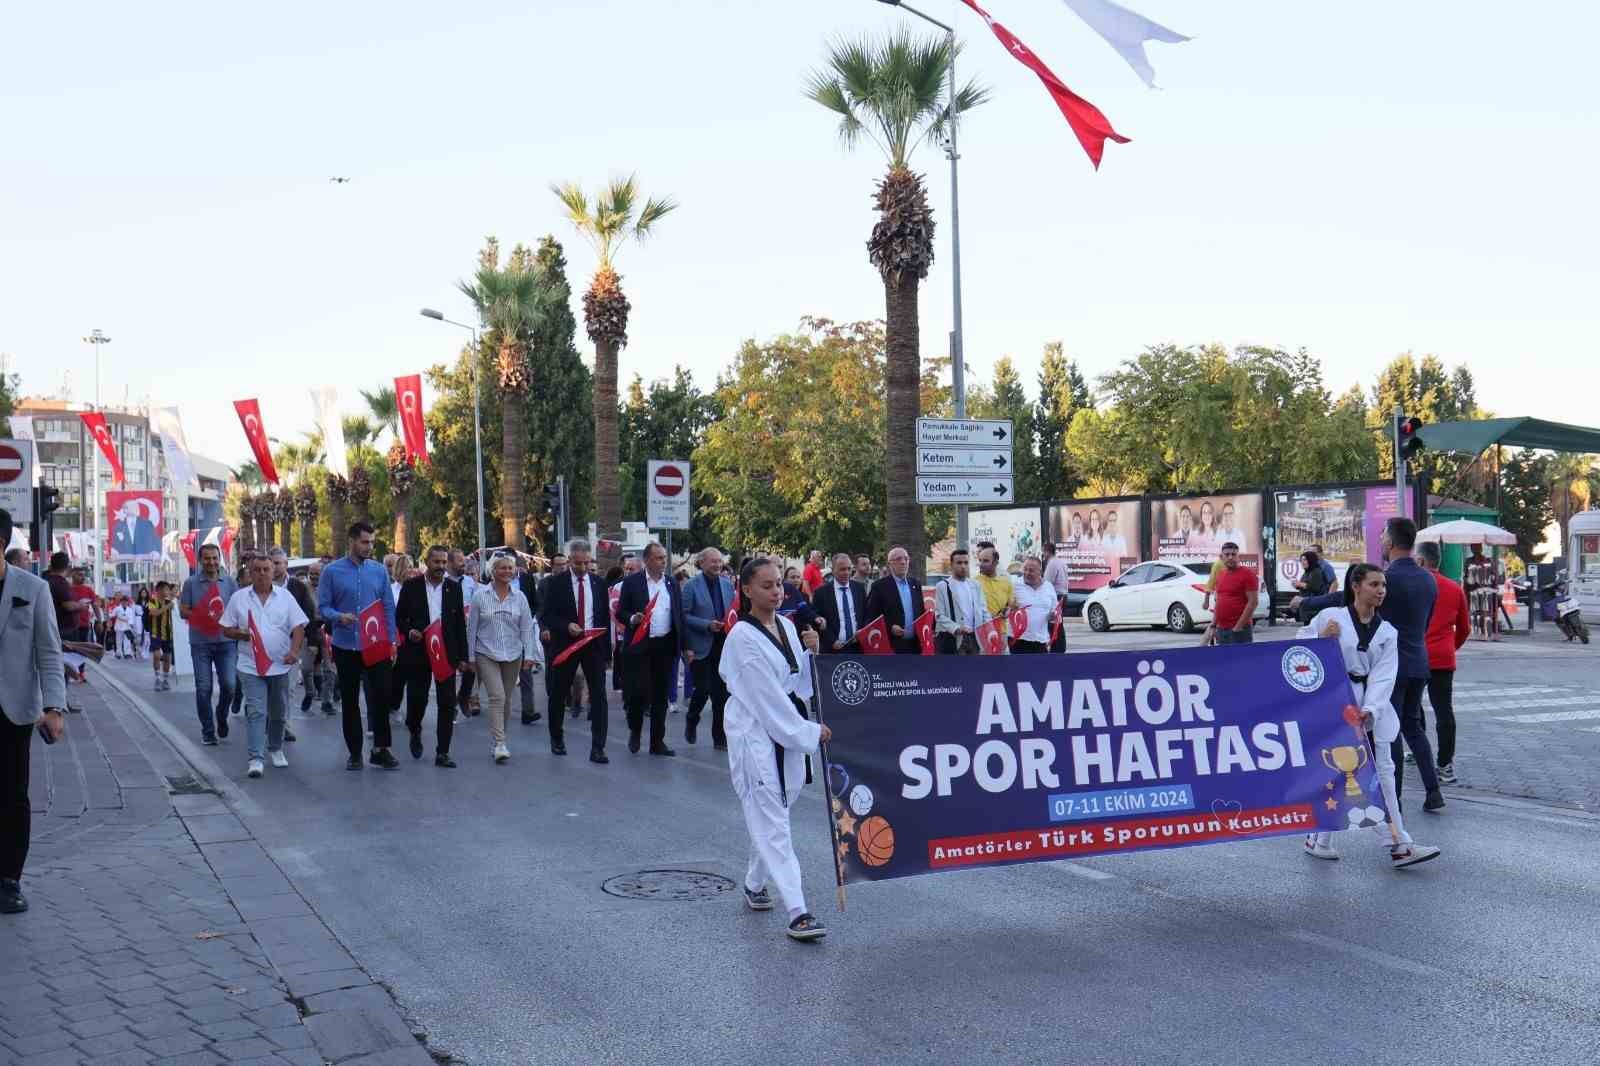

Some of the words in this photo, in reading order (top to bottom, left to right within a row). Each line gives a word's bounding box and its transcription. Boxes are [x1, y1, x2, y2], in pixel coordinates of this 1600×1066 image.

[943, 433, 969, 441] Merkezi
[922, 452, 954, 463] Ketem
[923, 481, 956, 492] Yedam
[975, 660, 1214, 735] AMATÖR
[899, 738, 1060, 799] SPOR
[1072, 721, 1306, 785] HAFTASI
[1055, 797, 1100, 816] 07-11
[1104, 791, 1145, 812] EKİM
[1149, 790, 1188, 808] 2024
[934, 839, 1032, 860] Amatörler
[1038, 829, 1094, 848] Türk
[1103, 818, 1221, 843] Sporunun
[1228, 811, 1310, 830] Kalbidir
